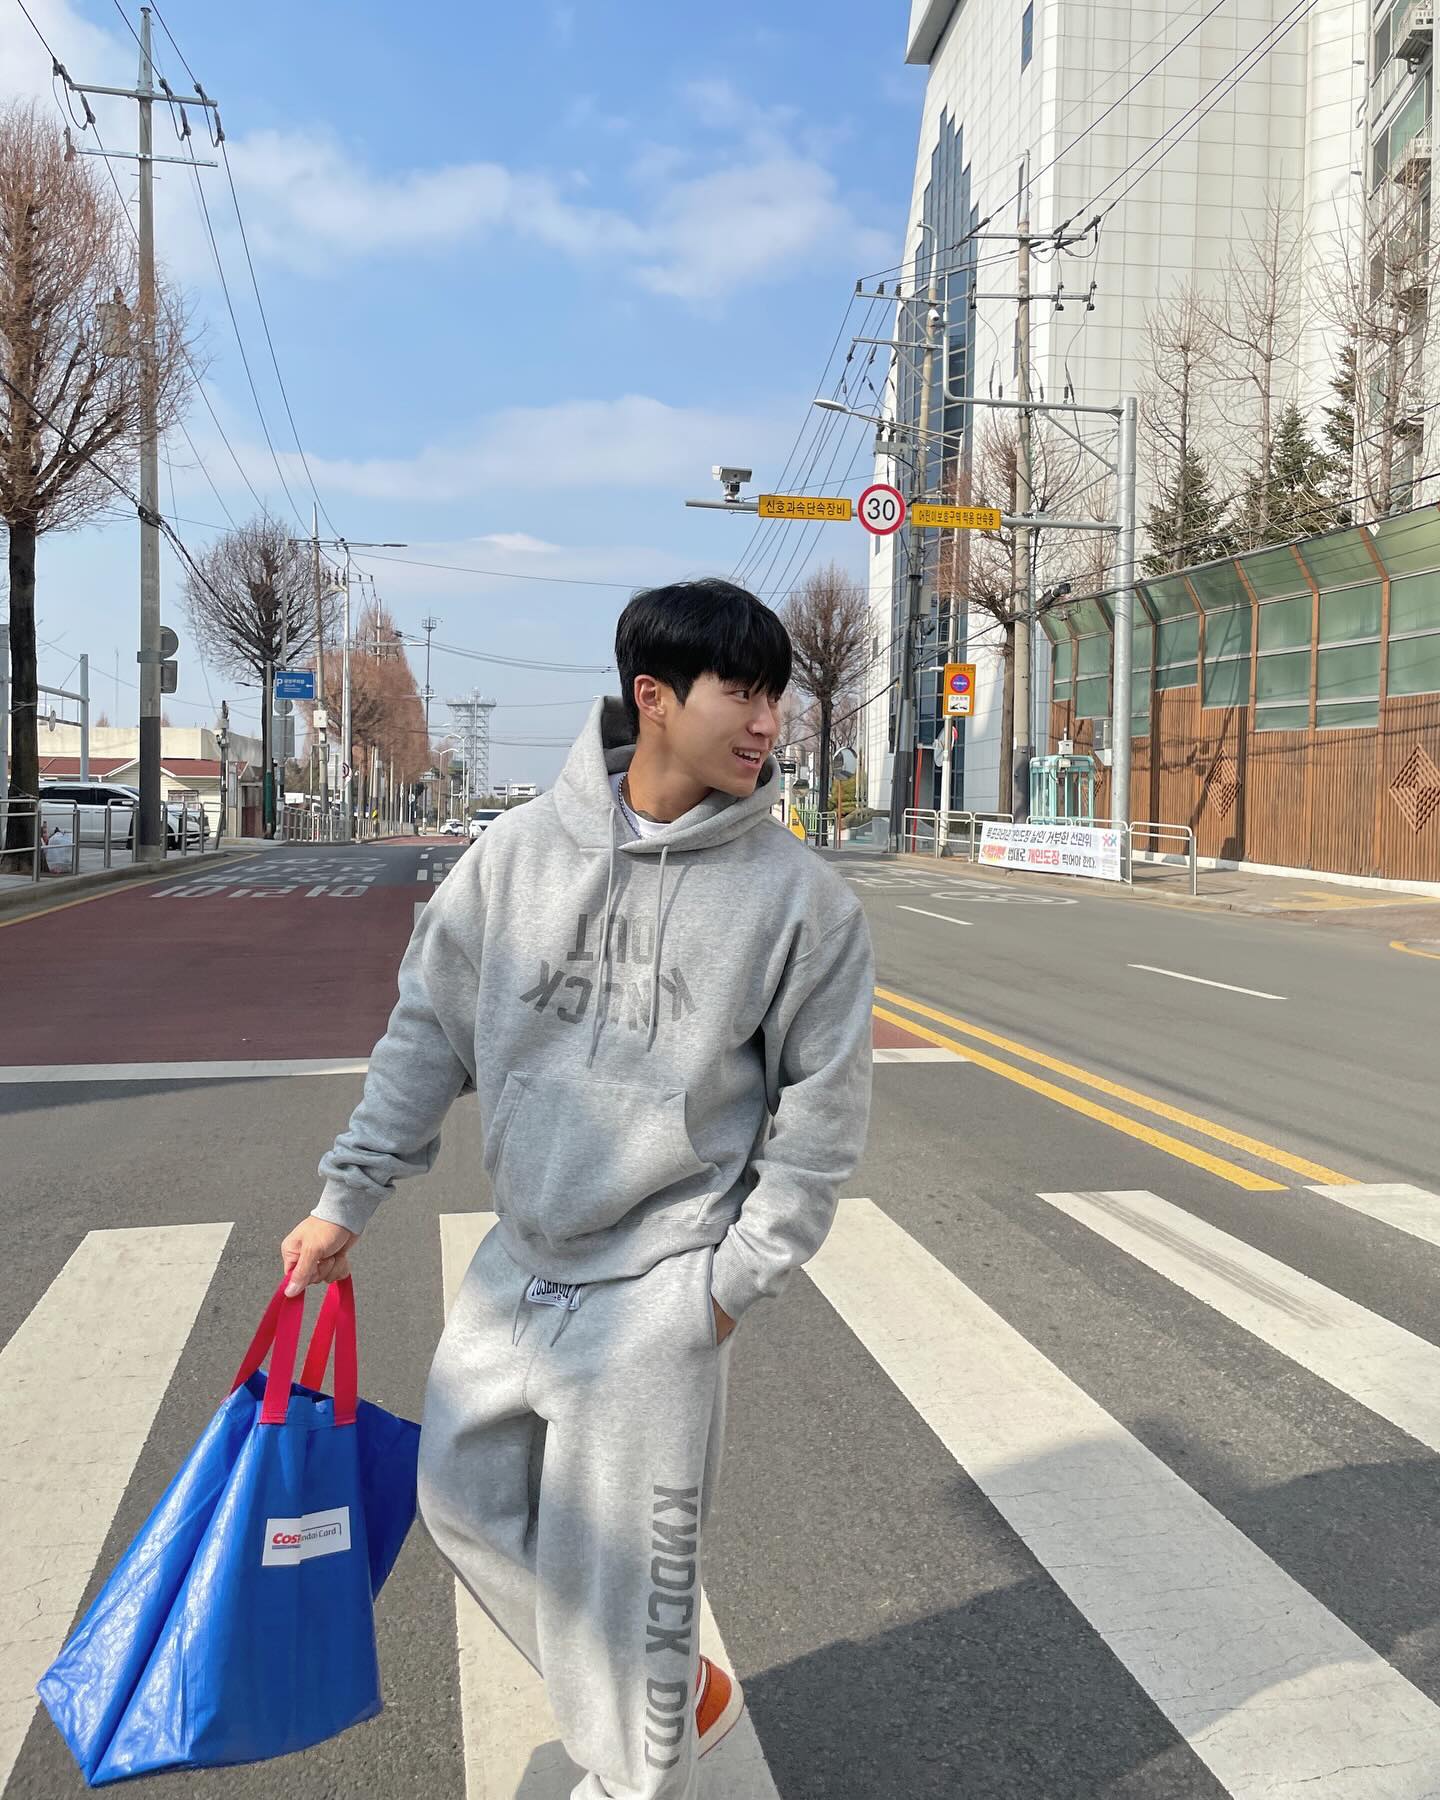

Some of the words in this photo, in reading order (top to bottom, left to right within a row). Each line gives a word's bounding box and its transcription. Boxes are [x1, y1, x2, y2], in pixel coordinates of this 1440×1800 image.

[867, 497, 896, 521] 30
[1045, 830, 1069, 845] 거부한
[1070, 832, 1092, 848] 선관위
[1027, 848, 1060, 865] 개인도장
[151, 885, 369, 898] 어린이
[318, 1527, 337, 1538] Card
